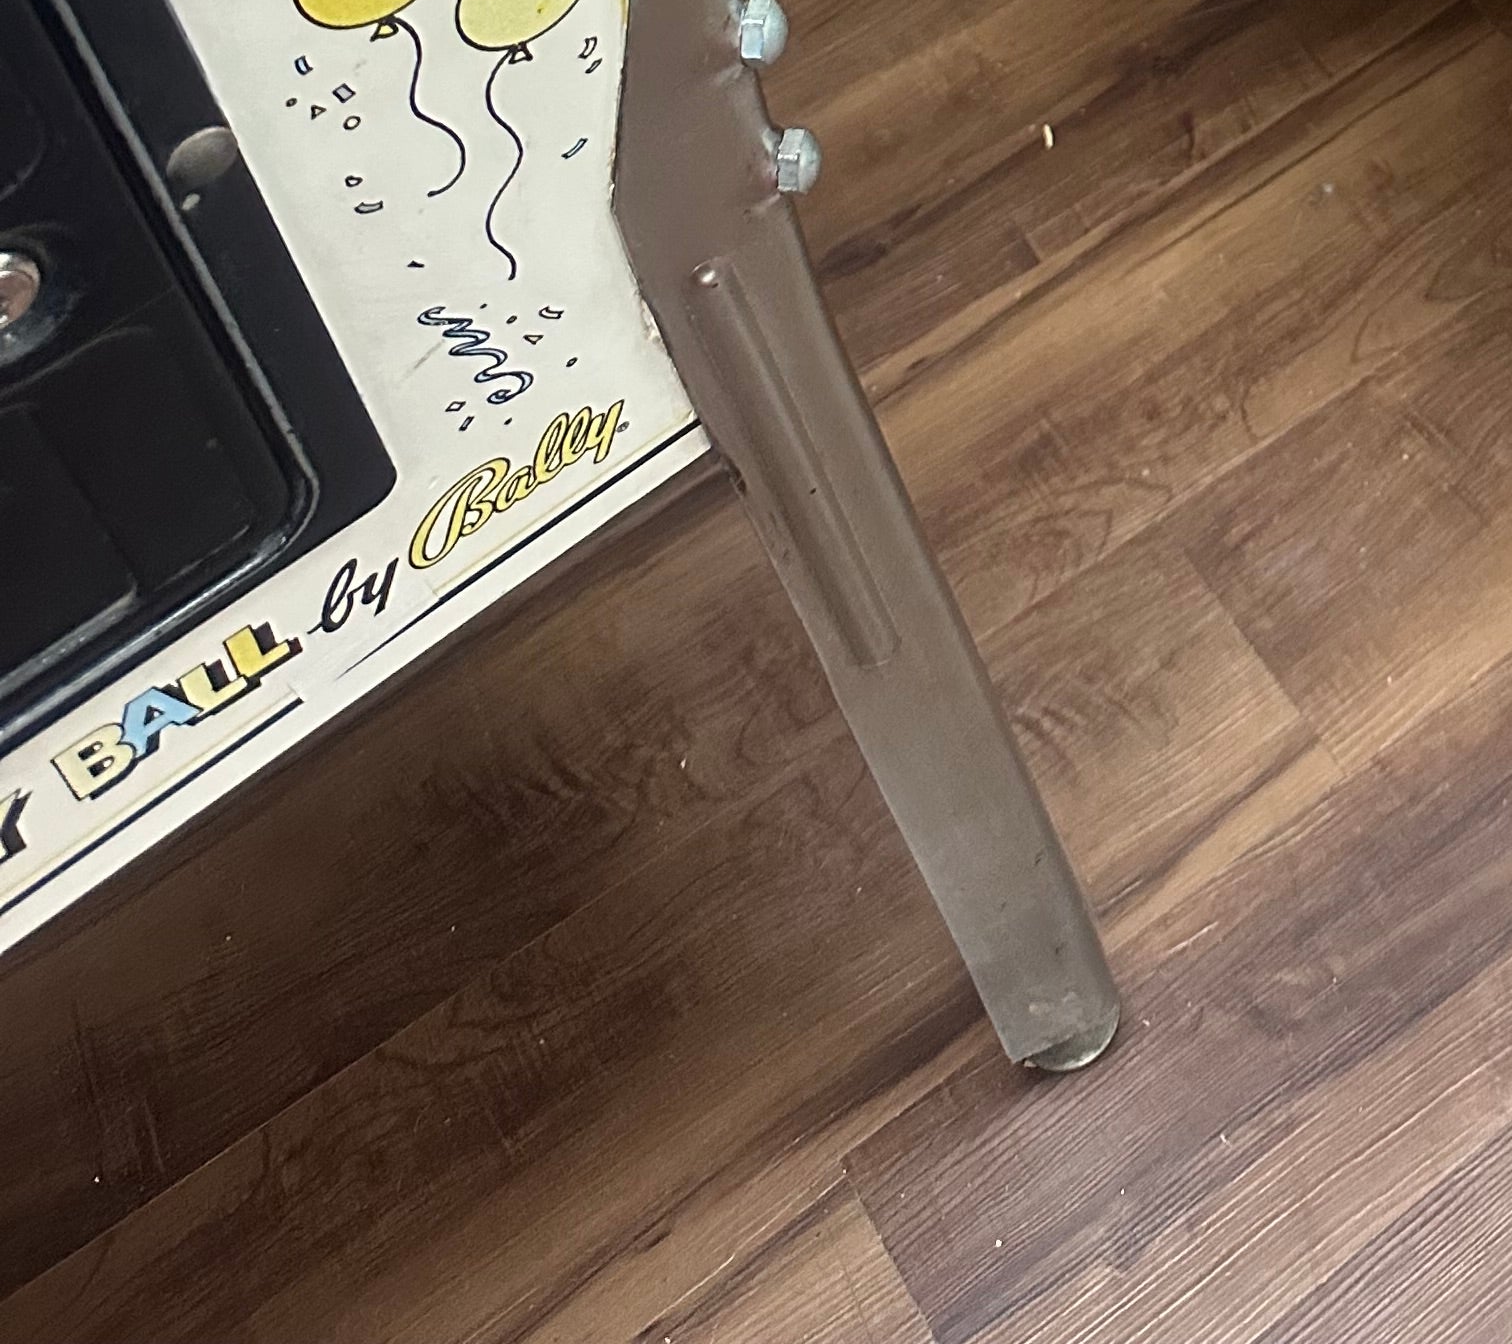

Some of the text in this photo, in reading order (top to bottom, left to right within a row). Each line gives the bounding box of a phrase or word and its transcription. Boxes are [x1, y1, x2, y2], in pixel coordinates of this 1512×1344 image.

[51, 398, 626, 802] BALL by Bally
